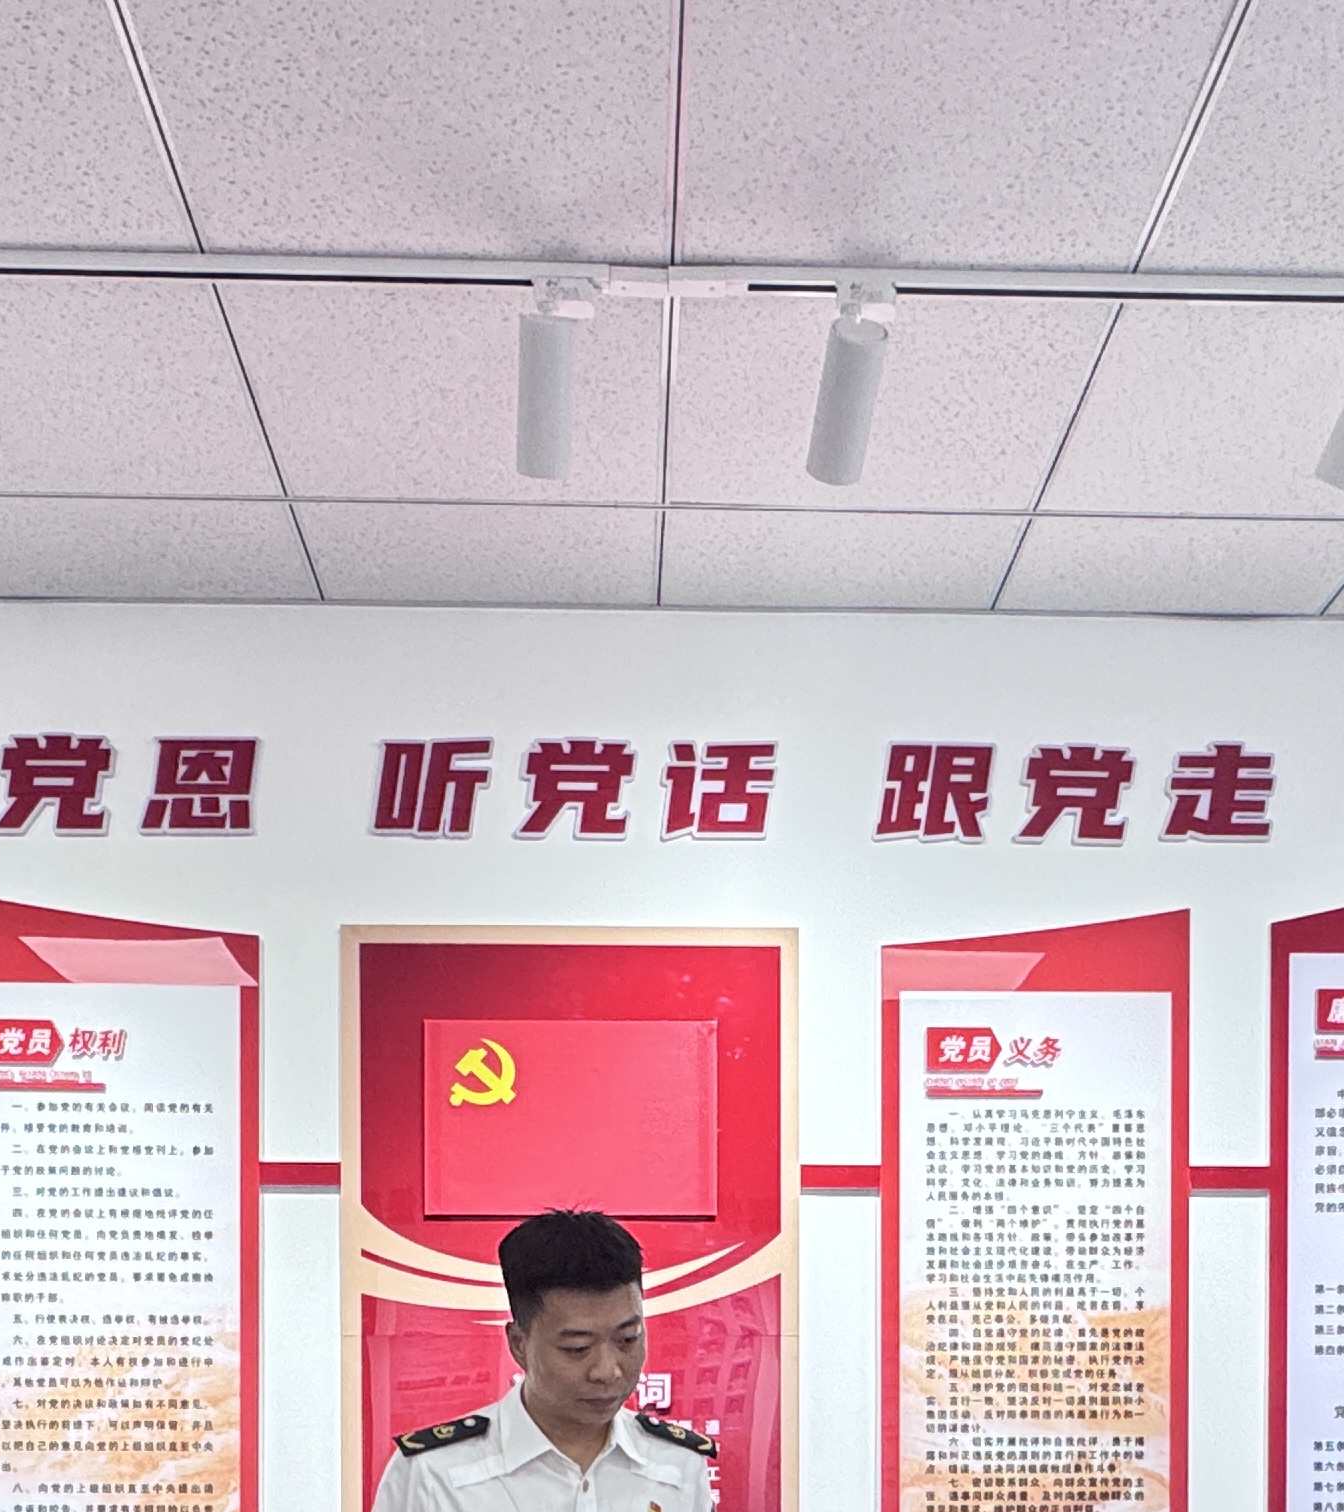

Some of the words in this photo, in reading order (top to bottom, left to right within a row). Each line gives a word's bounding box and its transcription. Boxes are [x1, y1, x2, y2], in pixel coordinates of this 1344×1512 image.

[372, 737, 778, 841] 听党话
[872, 741, 1275, 845] 跟党走
[69, 1028, 126, 1058] 权利
[939, 1035, 992, 1062] 党员
[1006, 1036, 1062, 1064] 义务
